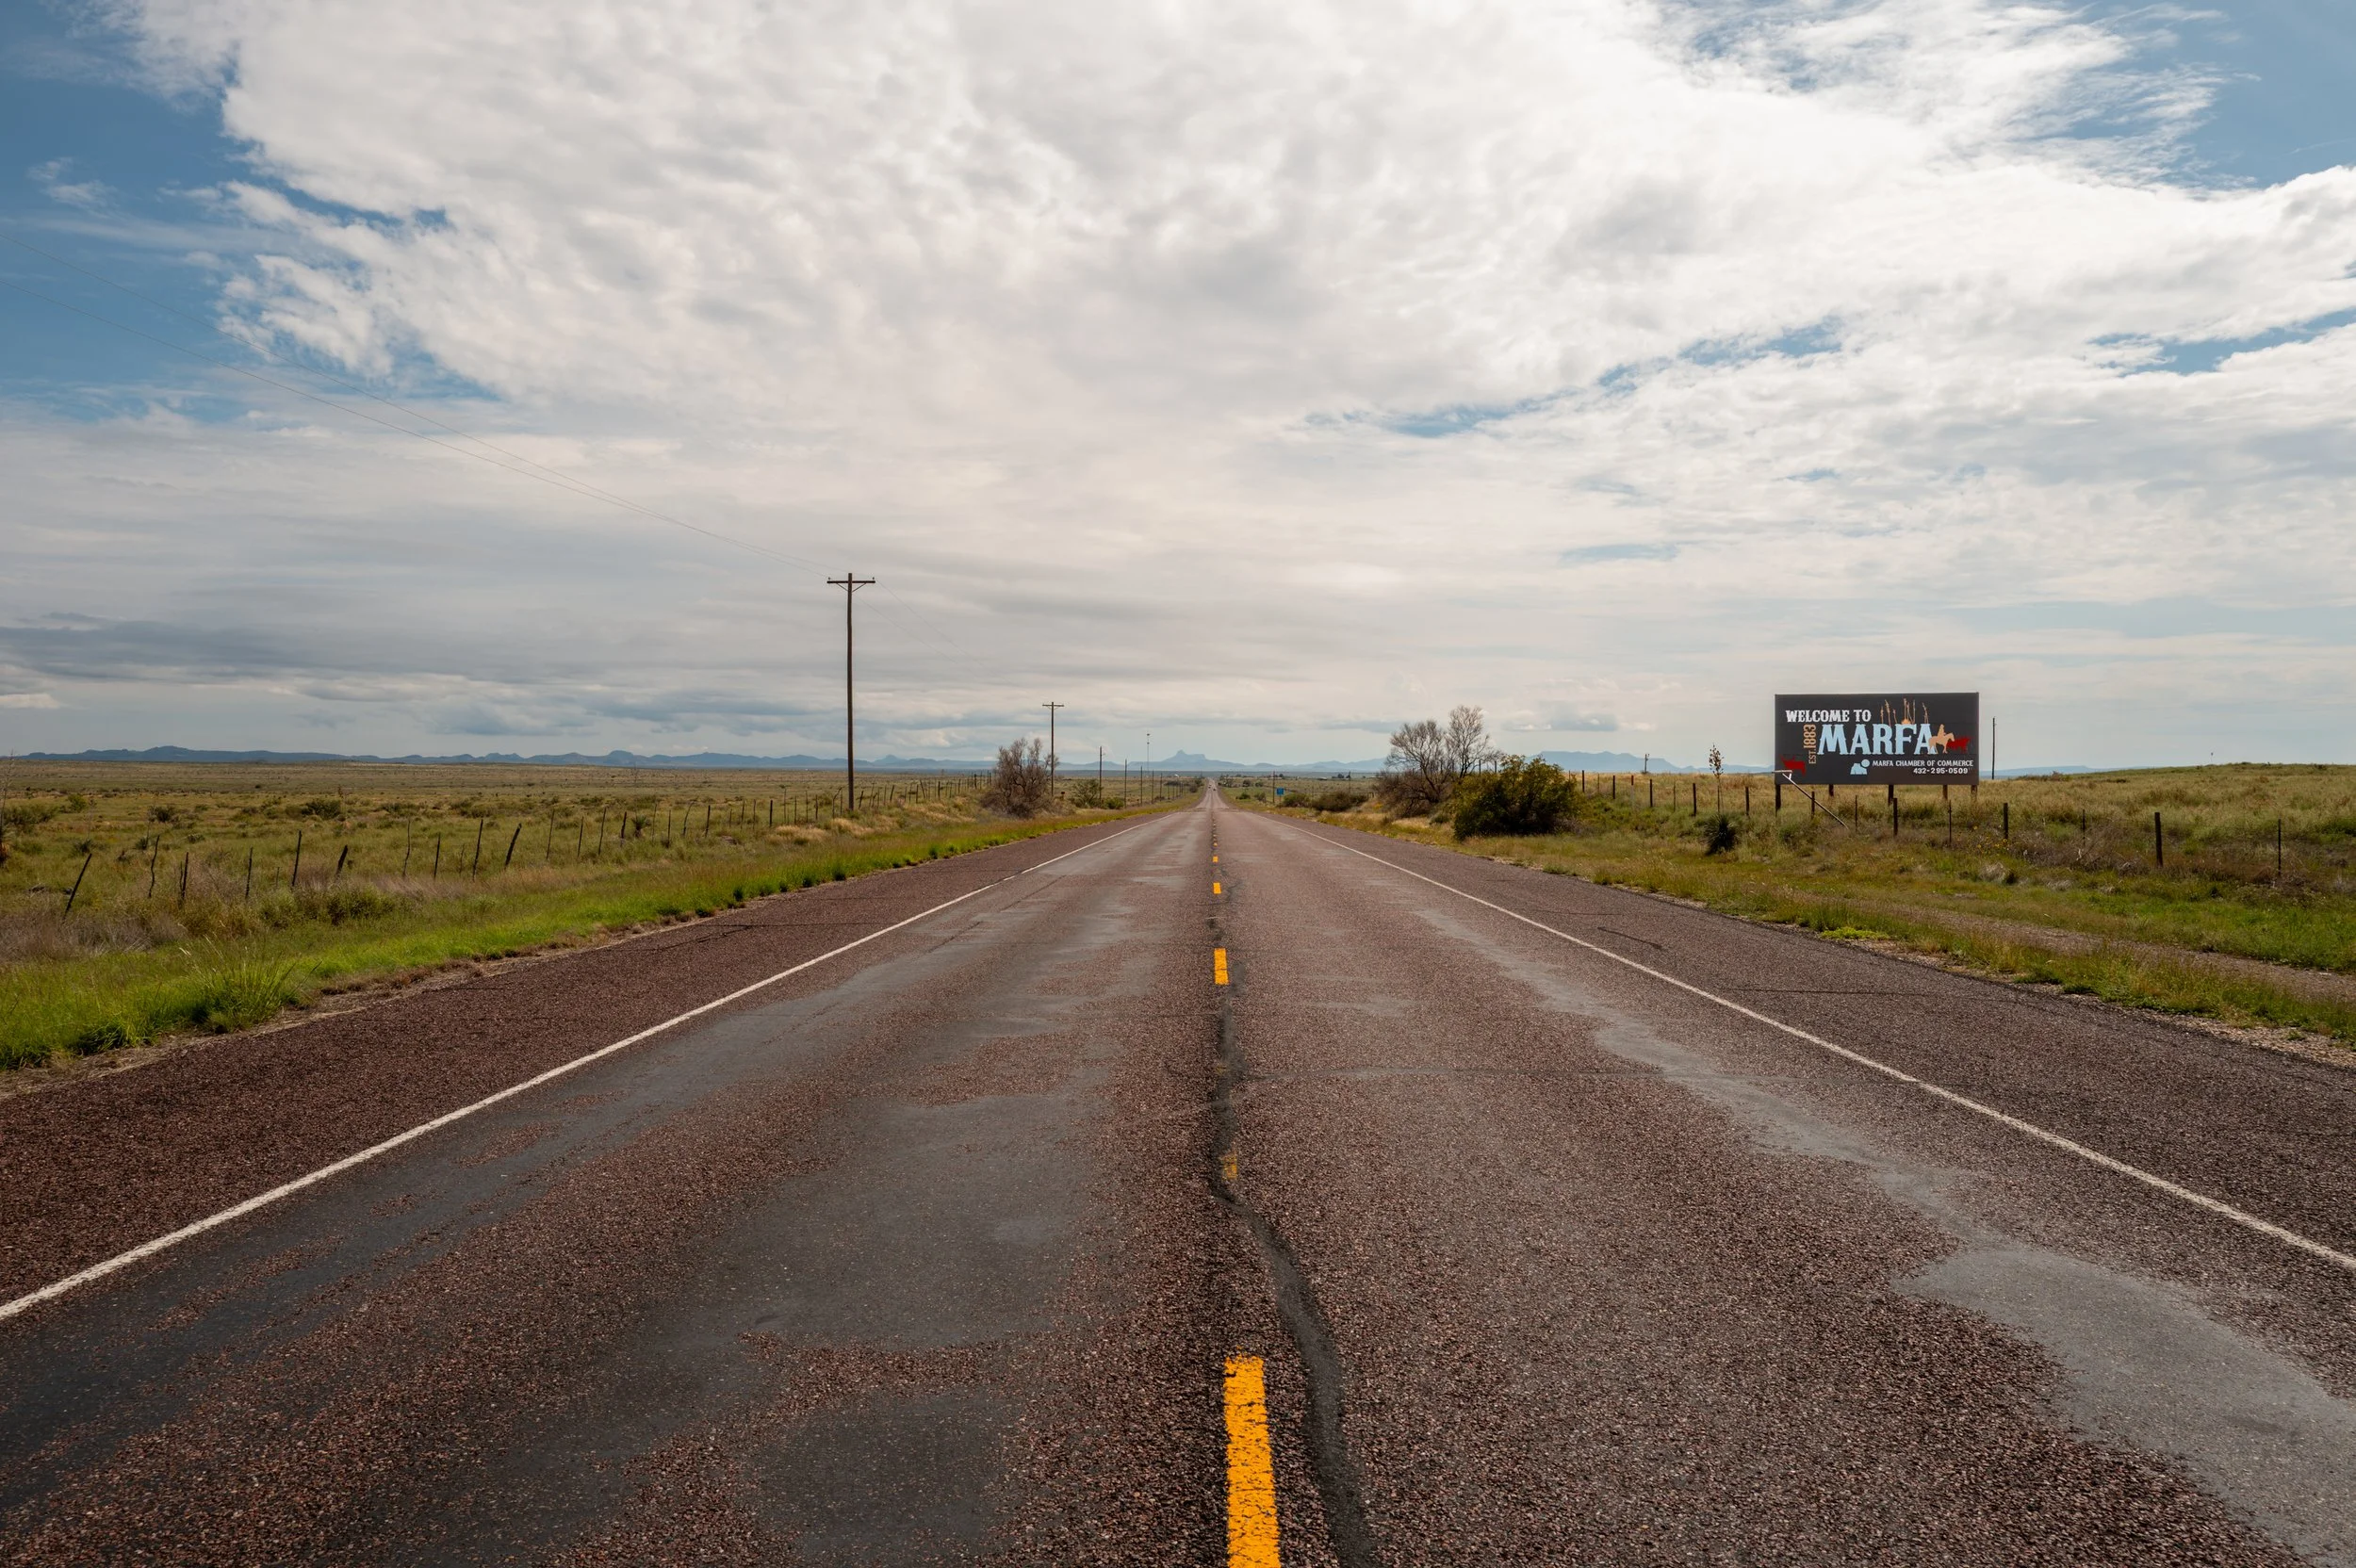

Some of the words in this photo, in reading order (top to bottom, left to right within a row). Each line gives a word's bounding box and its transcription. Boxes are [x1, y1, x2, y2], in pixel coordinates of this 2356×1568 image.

[1786, 710, 1849, 723] WELCOME
[1853, 710, 1872, 723] TO
[1817, 723, 1939, 755] MARFA
